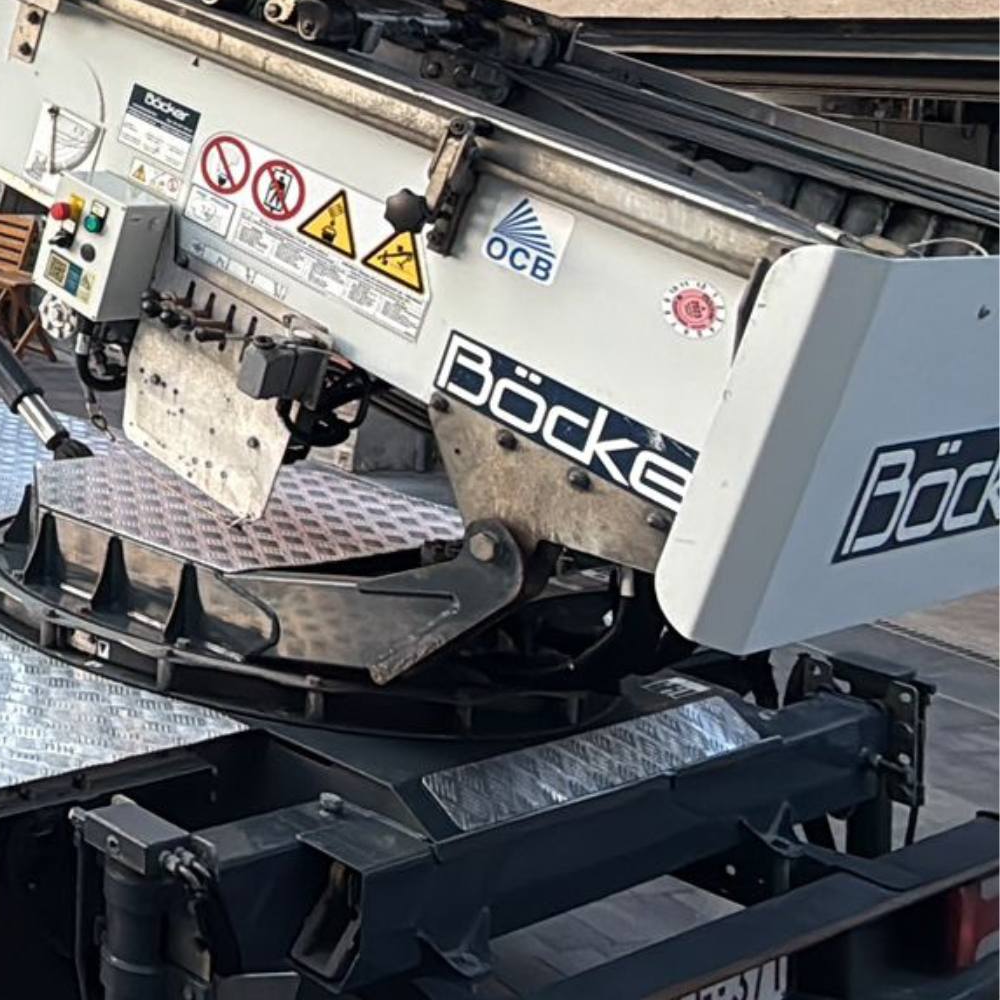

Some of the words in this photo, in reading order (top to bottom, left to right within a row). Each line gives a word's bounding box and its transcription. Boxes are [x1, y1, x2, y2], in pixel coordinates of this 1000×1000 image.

[486, 237, 553, 282] OCB
[437, 332, 695, 513] Böcke
[841, 439, 1000, 556] Böck
